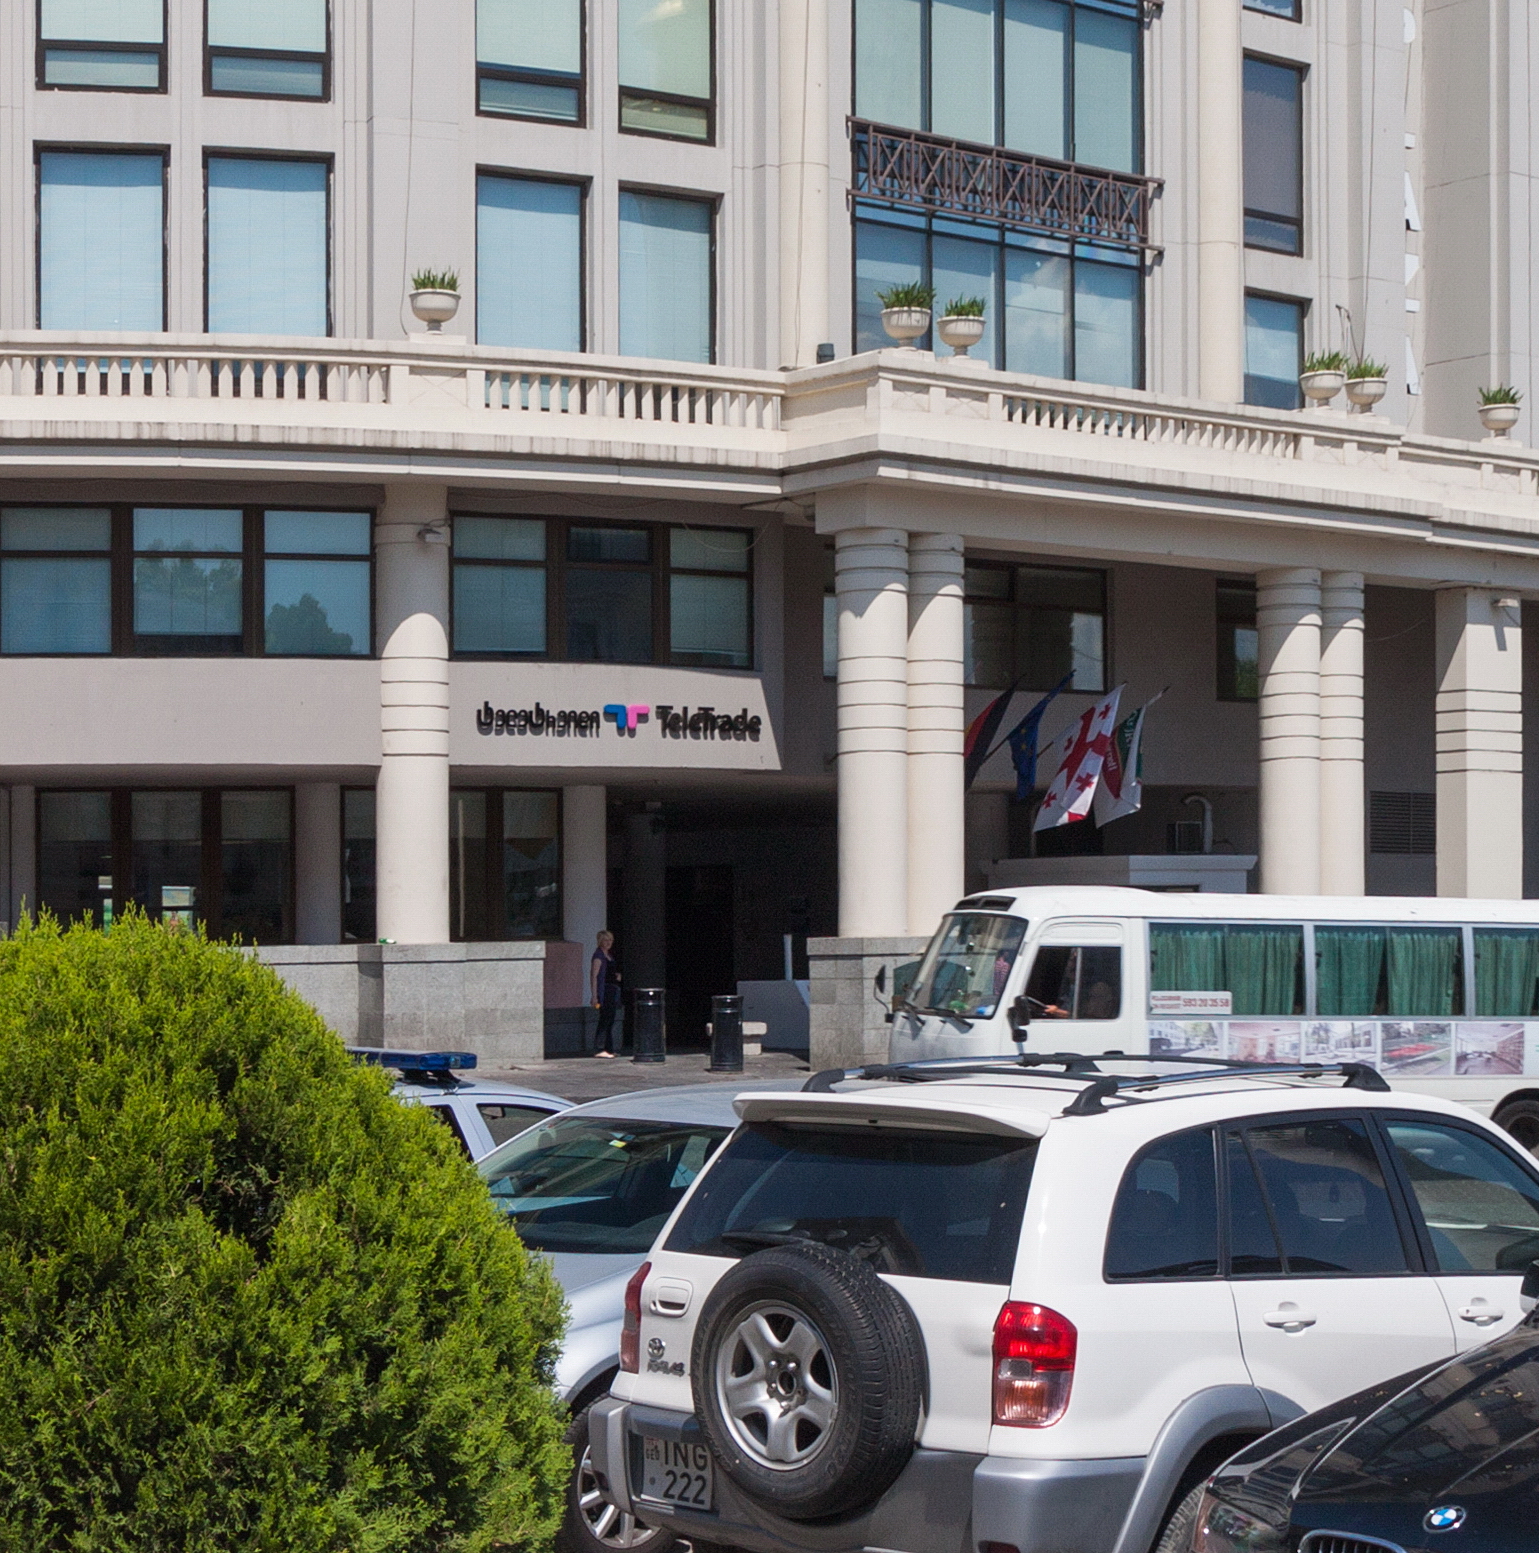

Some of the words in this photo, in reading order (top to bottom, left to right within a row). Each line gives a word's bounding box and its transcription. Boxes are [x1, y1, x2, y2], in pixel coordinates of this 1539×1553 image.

[656, 705, 762, 735] TeleTrade
[664, 1441, 708, 1472] ING
[663, 1469, 707, 1505] 222
